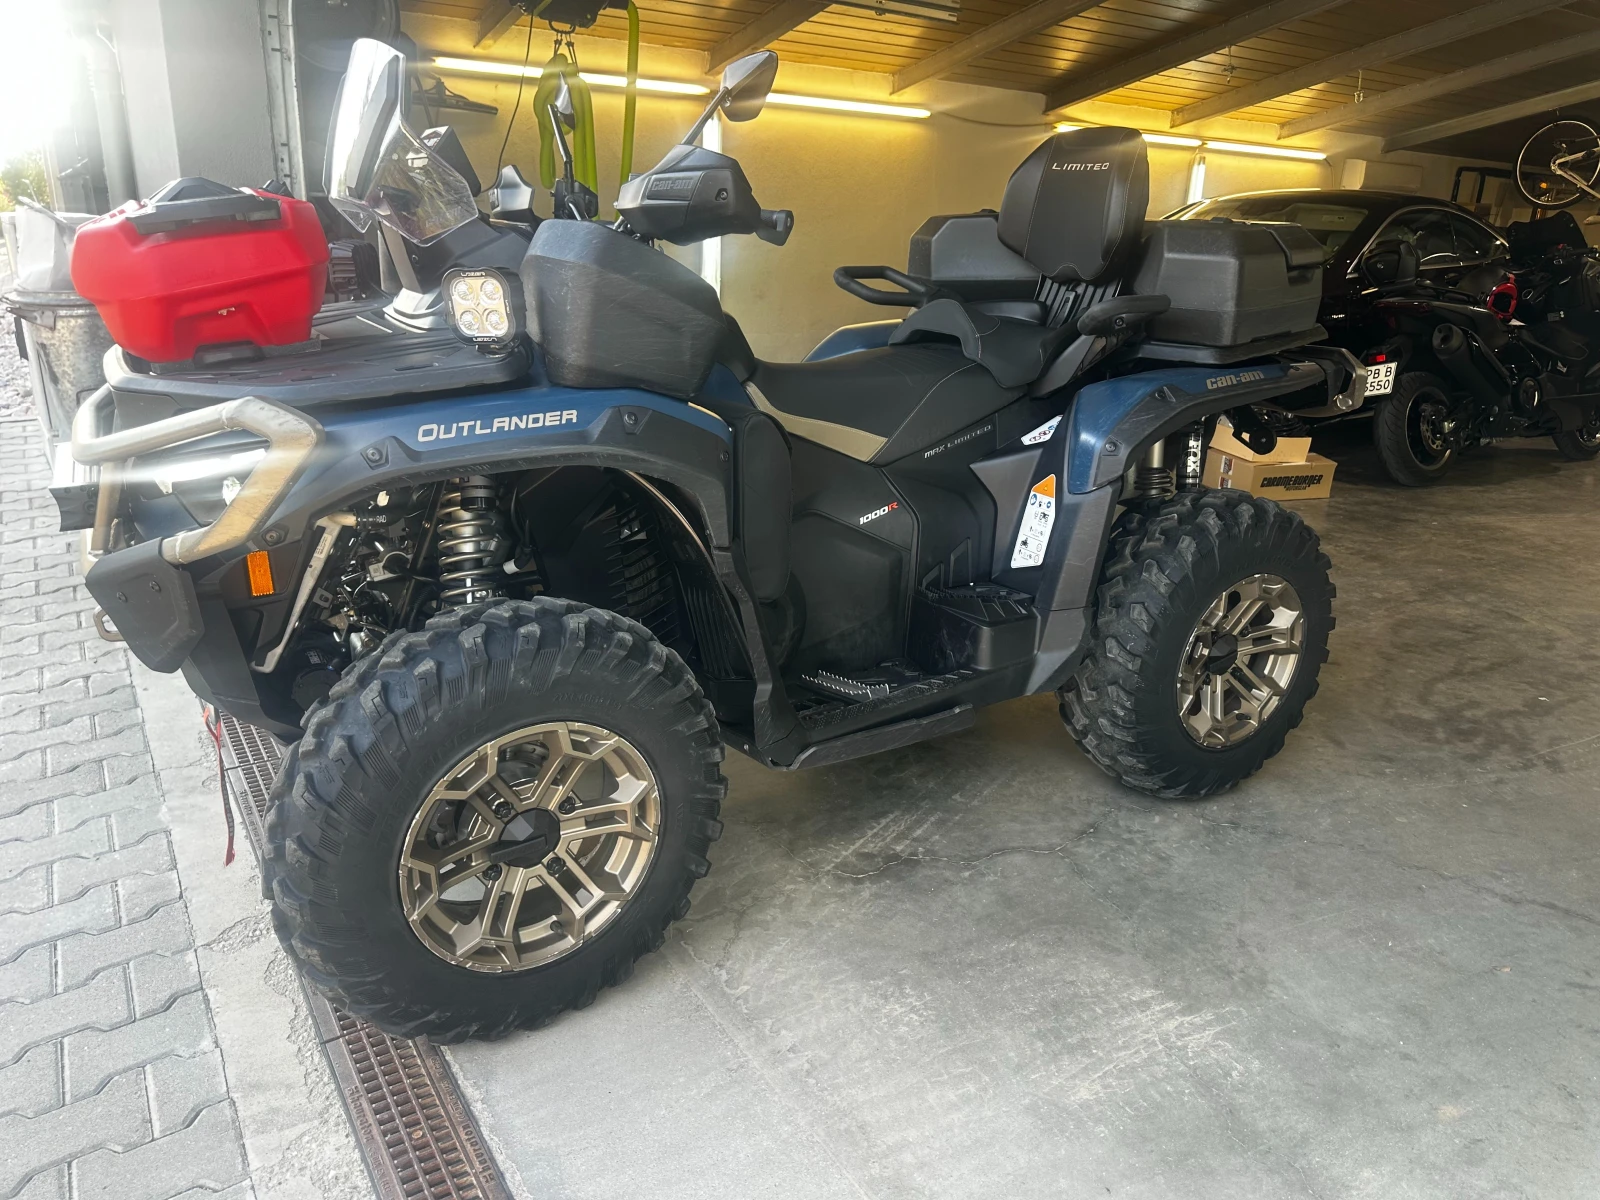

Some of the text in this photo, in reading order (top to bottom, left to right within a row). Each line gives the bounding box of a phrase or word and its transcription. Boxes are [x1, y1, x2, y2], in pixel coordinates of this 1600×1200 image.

[1052, 162, 1110, 171] LIMITED
[651, 180, 693, 190] can-am
[1206, 370, 1265, 390] can-am
[1385, 366, 1392, 377] B
[417, 409, 578, 443] OUTLANDER
[924, 424, 992, 459] MAX LIMITED
[1186, 439, 1202, 473] FOX
[859, 501, 899, 525] 1000R
